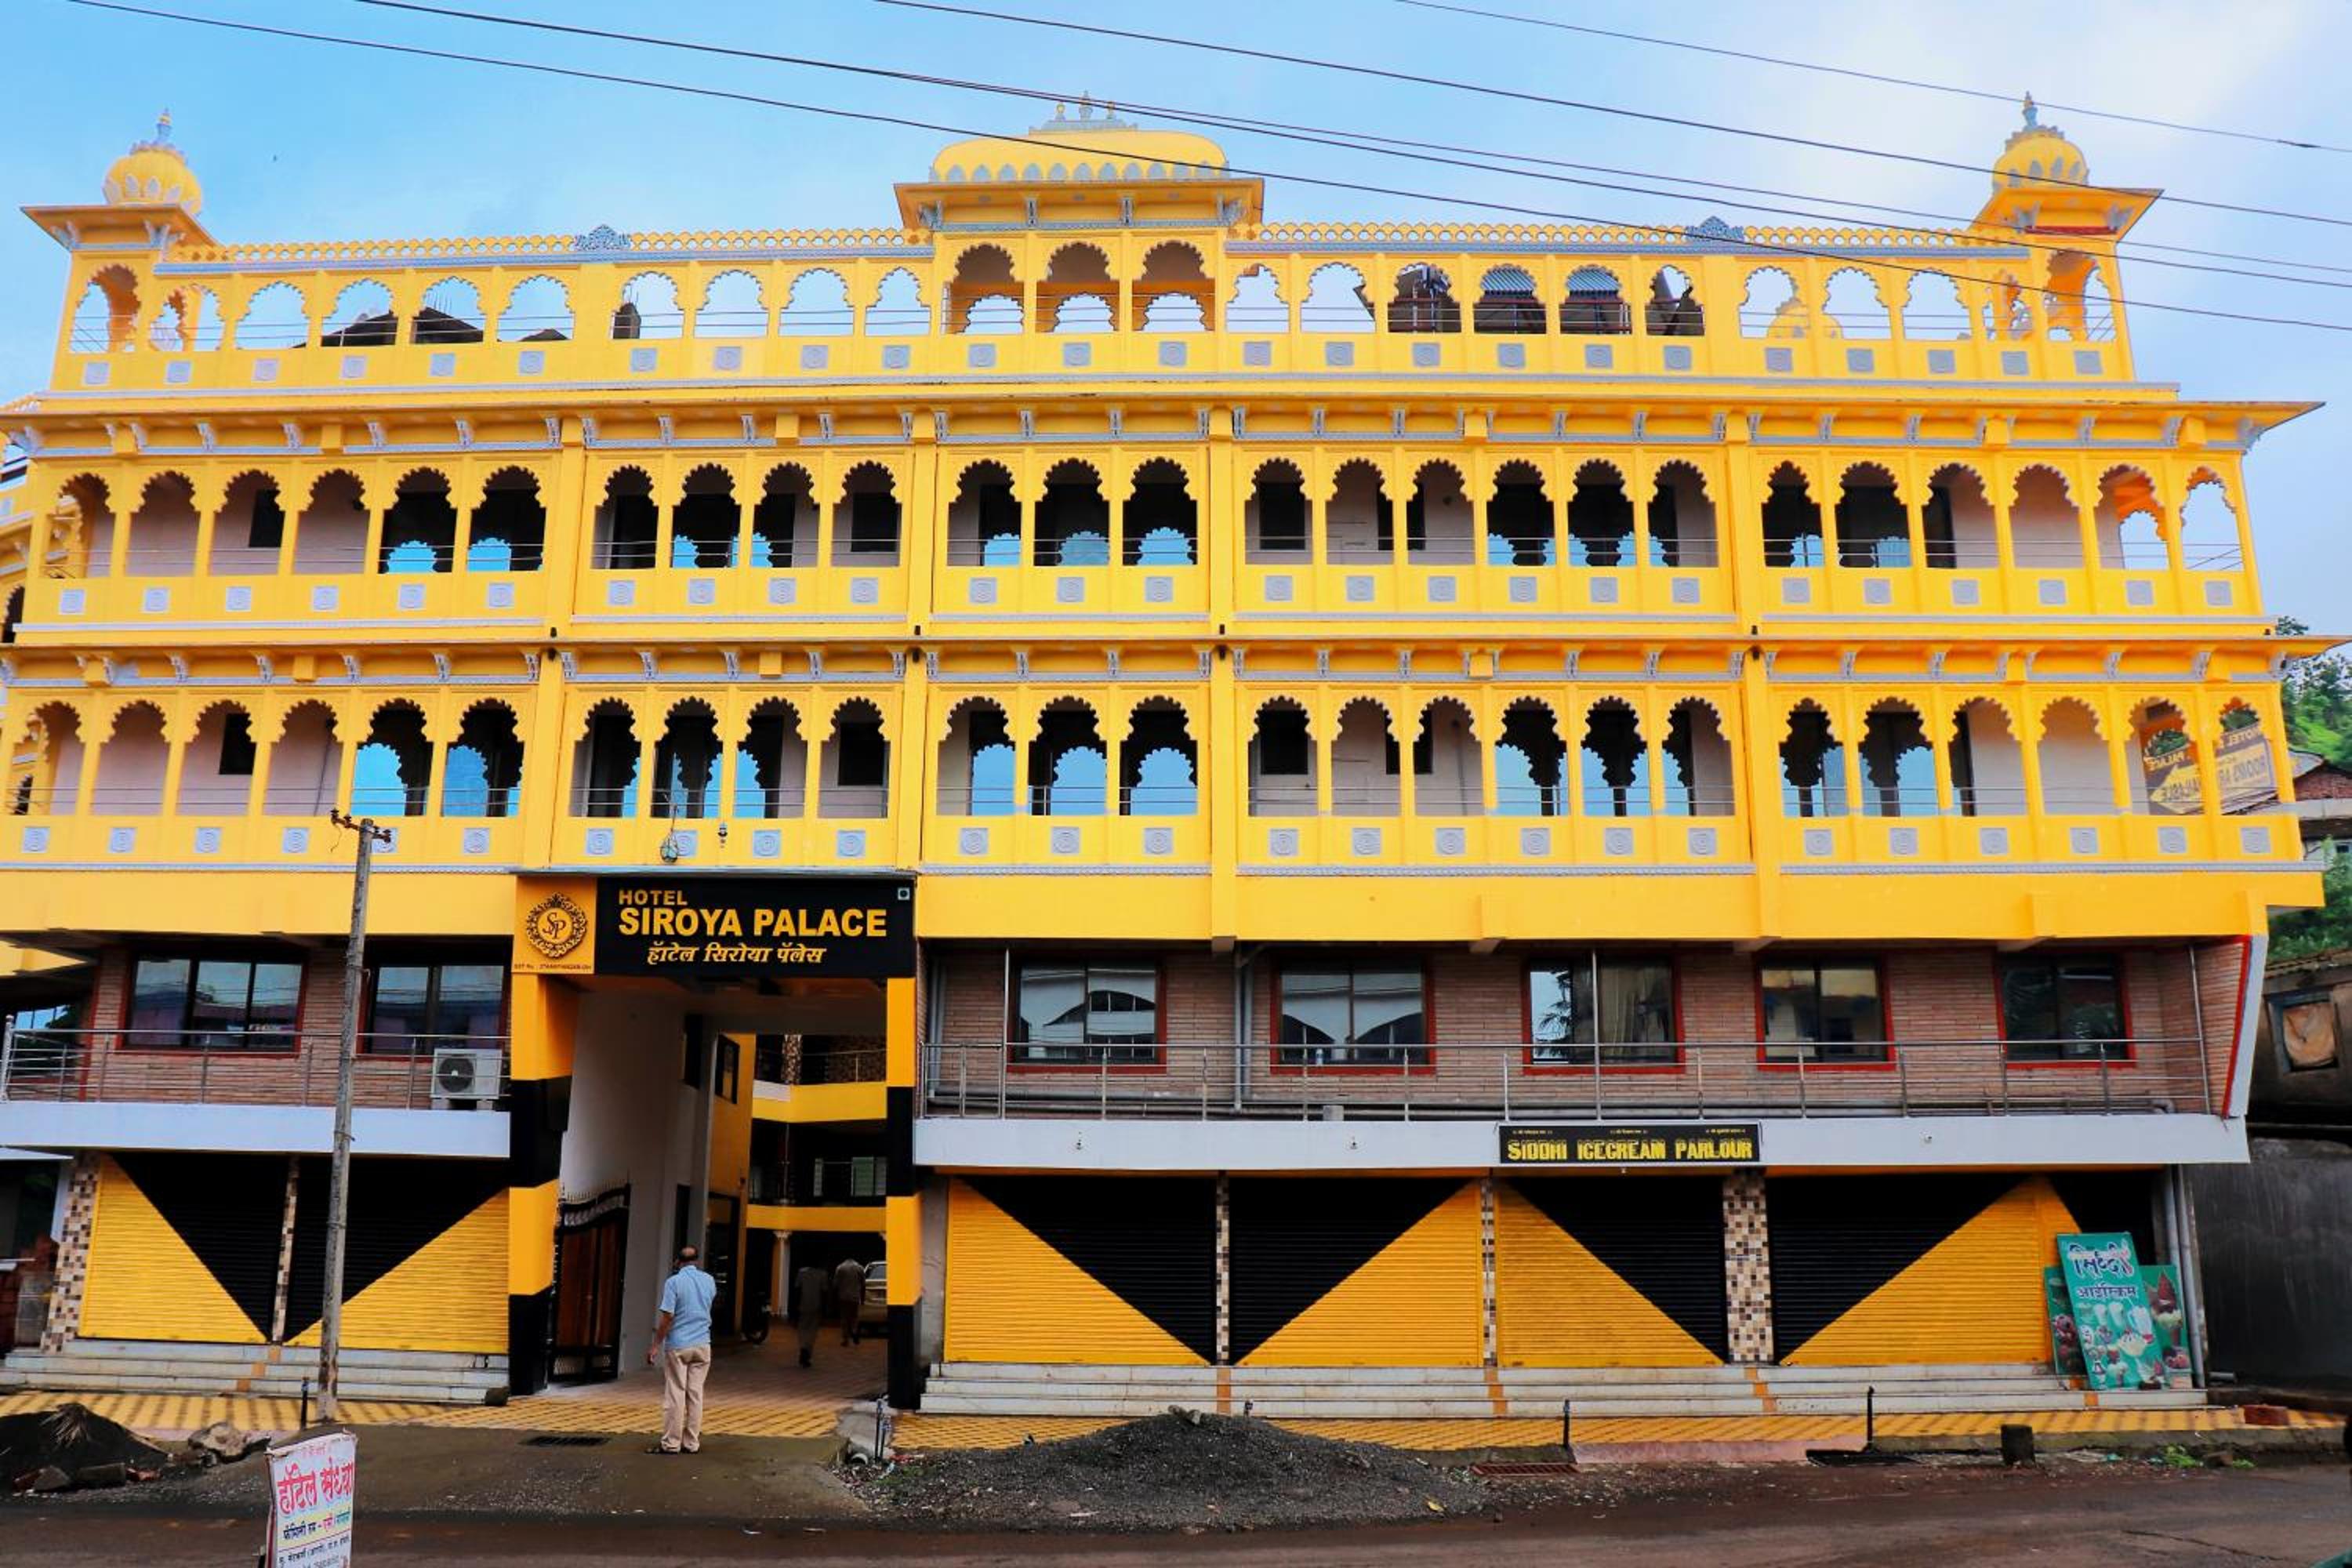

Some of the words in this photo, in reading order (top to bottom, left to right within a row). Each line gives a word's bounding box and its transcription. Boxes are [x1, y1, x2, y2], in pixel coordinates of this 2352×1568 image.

[619, 890, 688, 906] HOTEL
[619, 908, 742, 936] SIROYA
[753, 909, 887, 937] PALACE
[647, 941, 699, 965] हॉटेल
[702, 942, 773, 963] सिरोया
[777, 942, 827, 964] पॅलेस
[1508, 1140, 1567, 1160] SIDDHI
[1577, 1139, 1666, 1160] ICECREAM
[1675, 1138, 1752, 1160] PARLOUR
